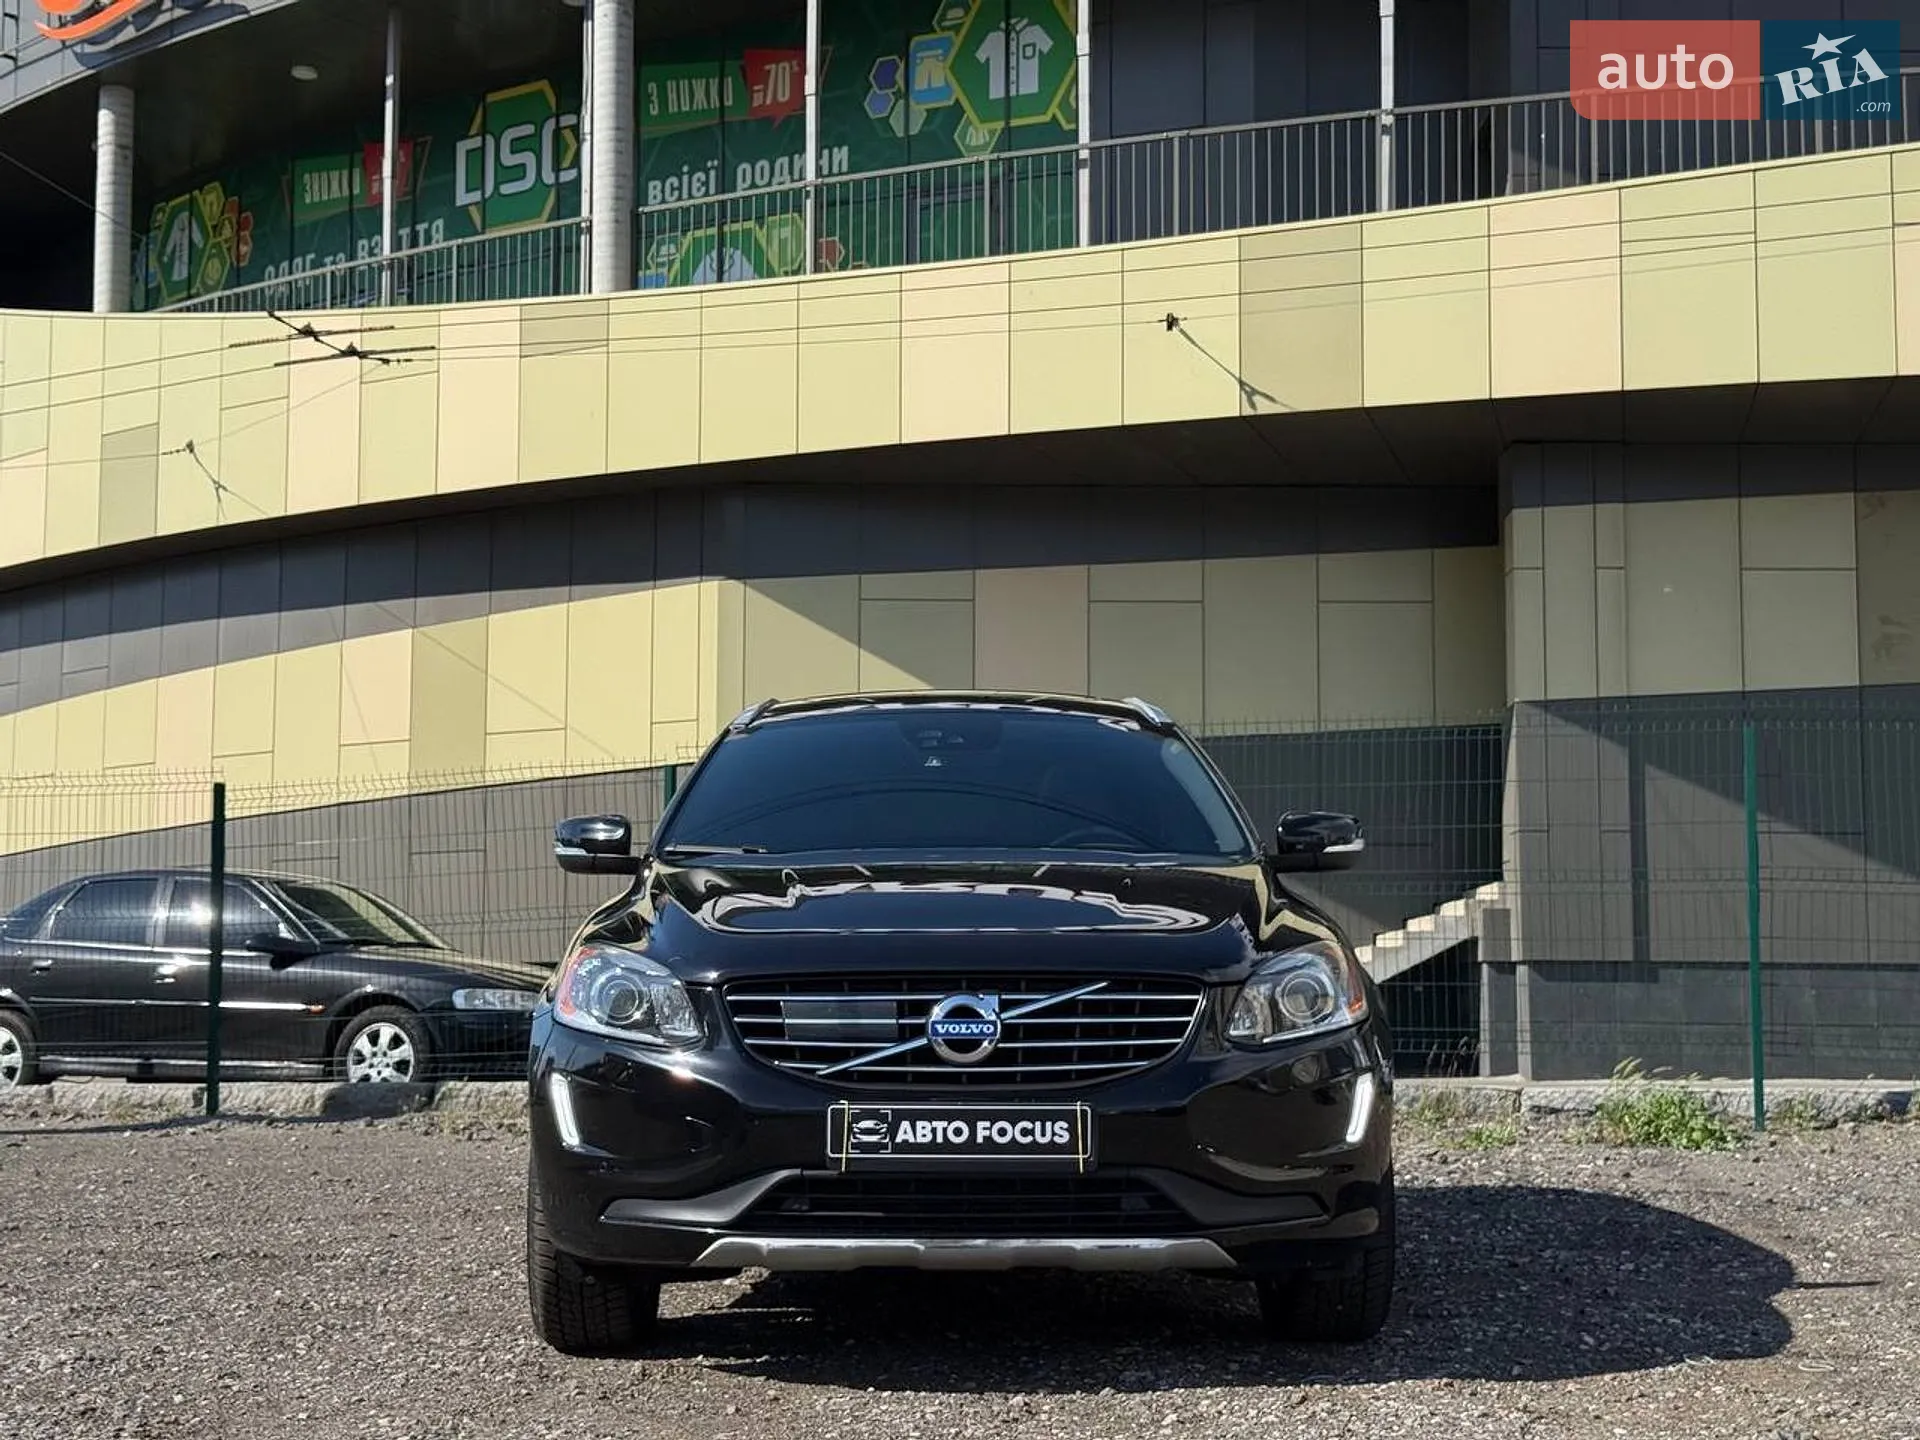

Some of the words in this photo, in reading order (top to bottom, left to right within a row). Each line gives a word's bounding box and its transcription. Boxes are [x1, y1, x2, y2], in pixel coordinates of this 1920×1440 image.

[455, 113, 578, 207] DSC
[934, 1024, 994, 1034] VOLVO
[895, 1120, 970, 1144] АВТО
[976, 1120, 1070, 1144] FOCUS
